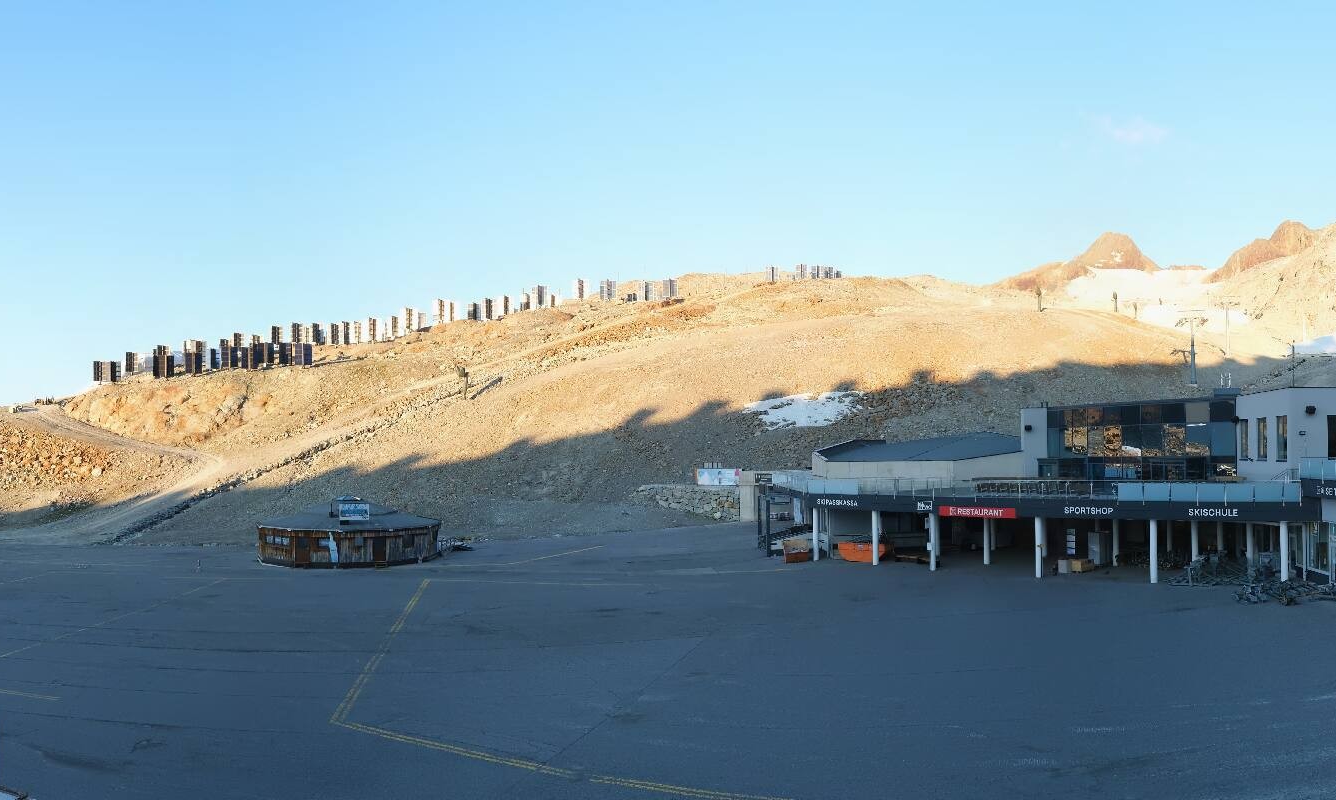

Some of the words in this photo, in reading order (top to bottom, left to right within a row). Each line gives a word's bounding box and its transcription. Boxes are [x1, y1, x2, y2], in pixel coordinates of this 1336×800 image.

[957, 508, 1004, 517] RESTAURANT
[1064, 506, 1114, 515] SPORTSHOP
[1188, 508, 1239, 517] SKISCHULE
